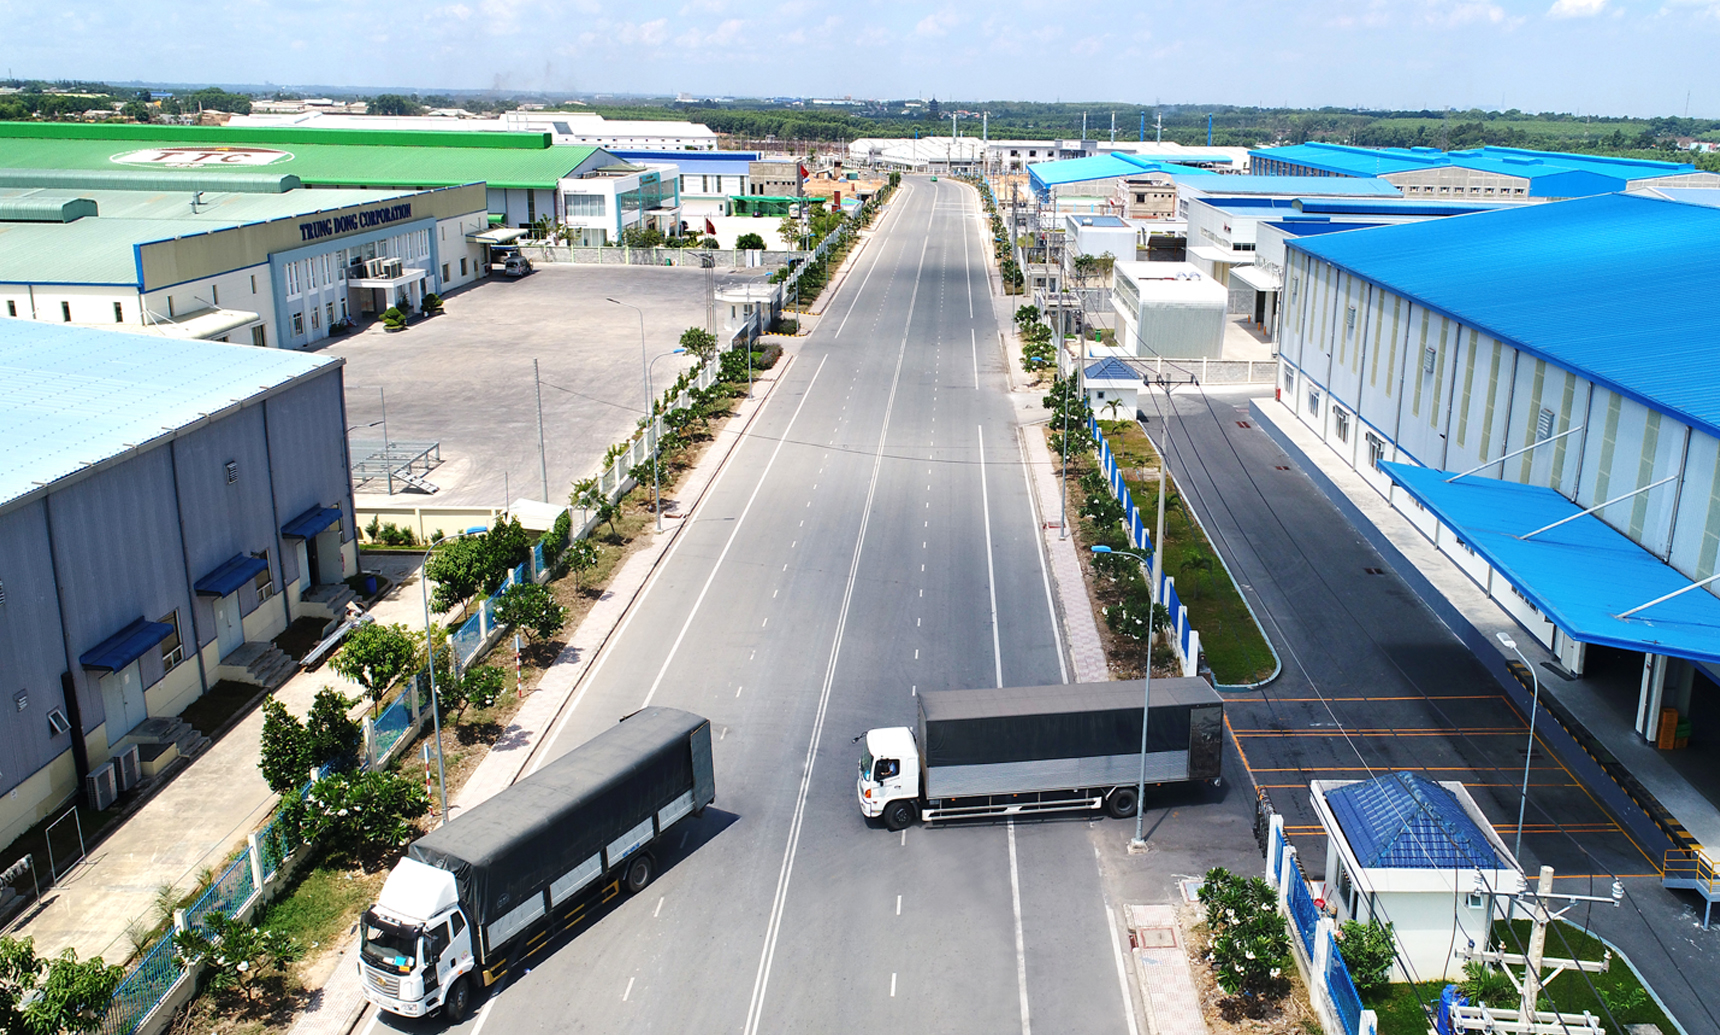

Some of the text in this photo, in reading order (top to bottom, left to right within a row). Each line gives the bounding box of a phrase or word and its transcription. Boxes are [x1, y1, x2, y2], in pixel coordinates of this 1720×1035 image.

[299, 203, 412, 241] TRUNG DONG CORPORATION
